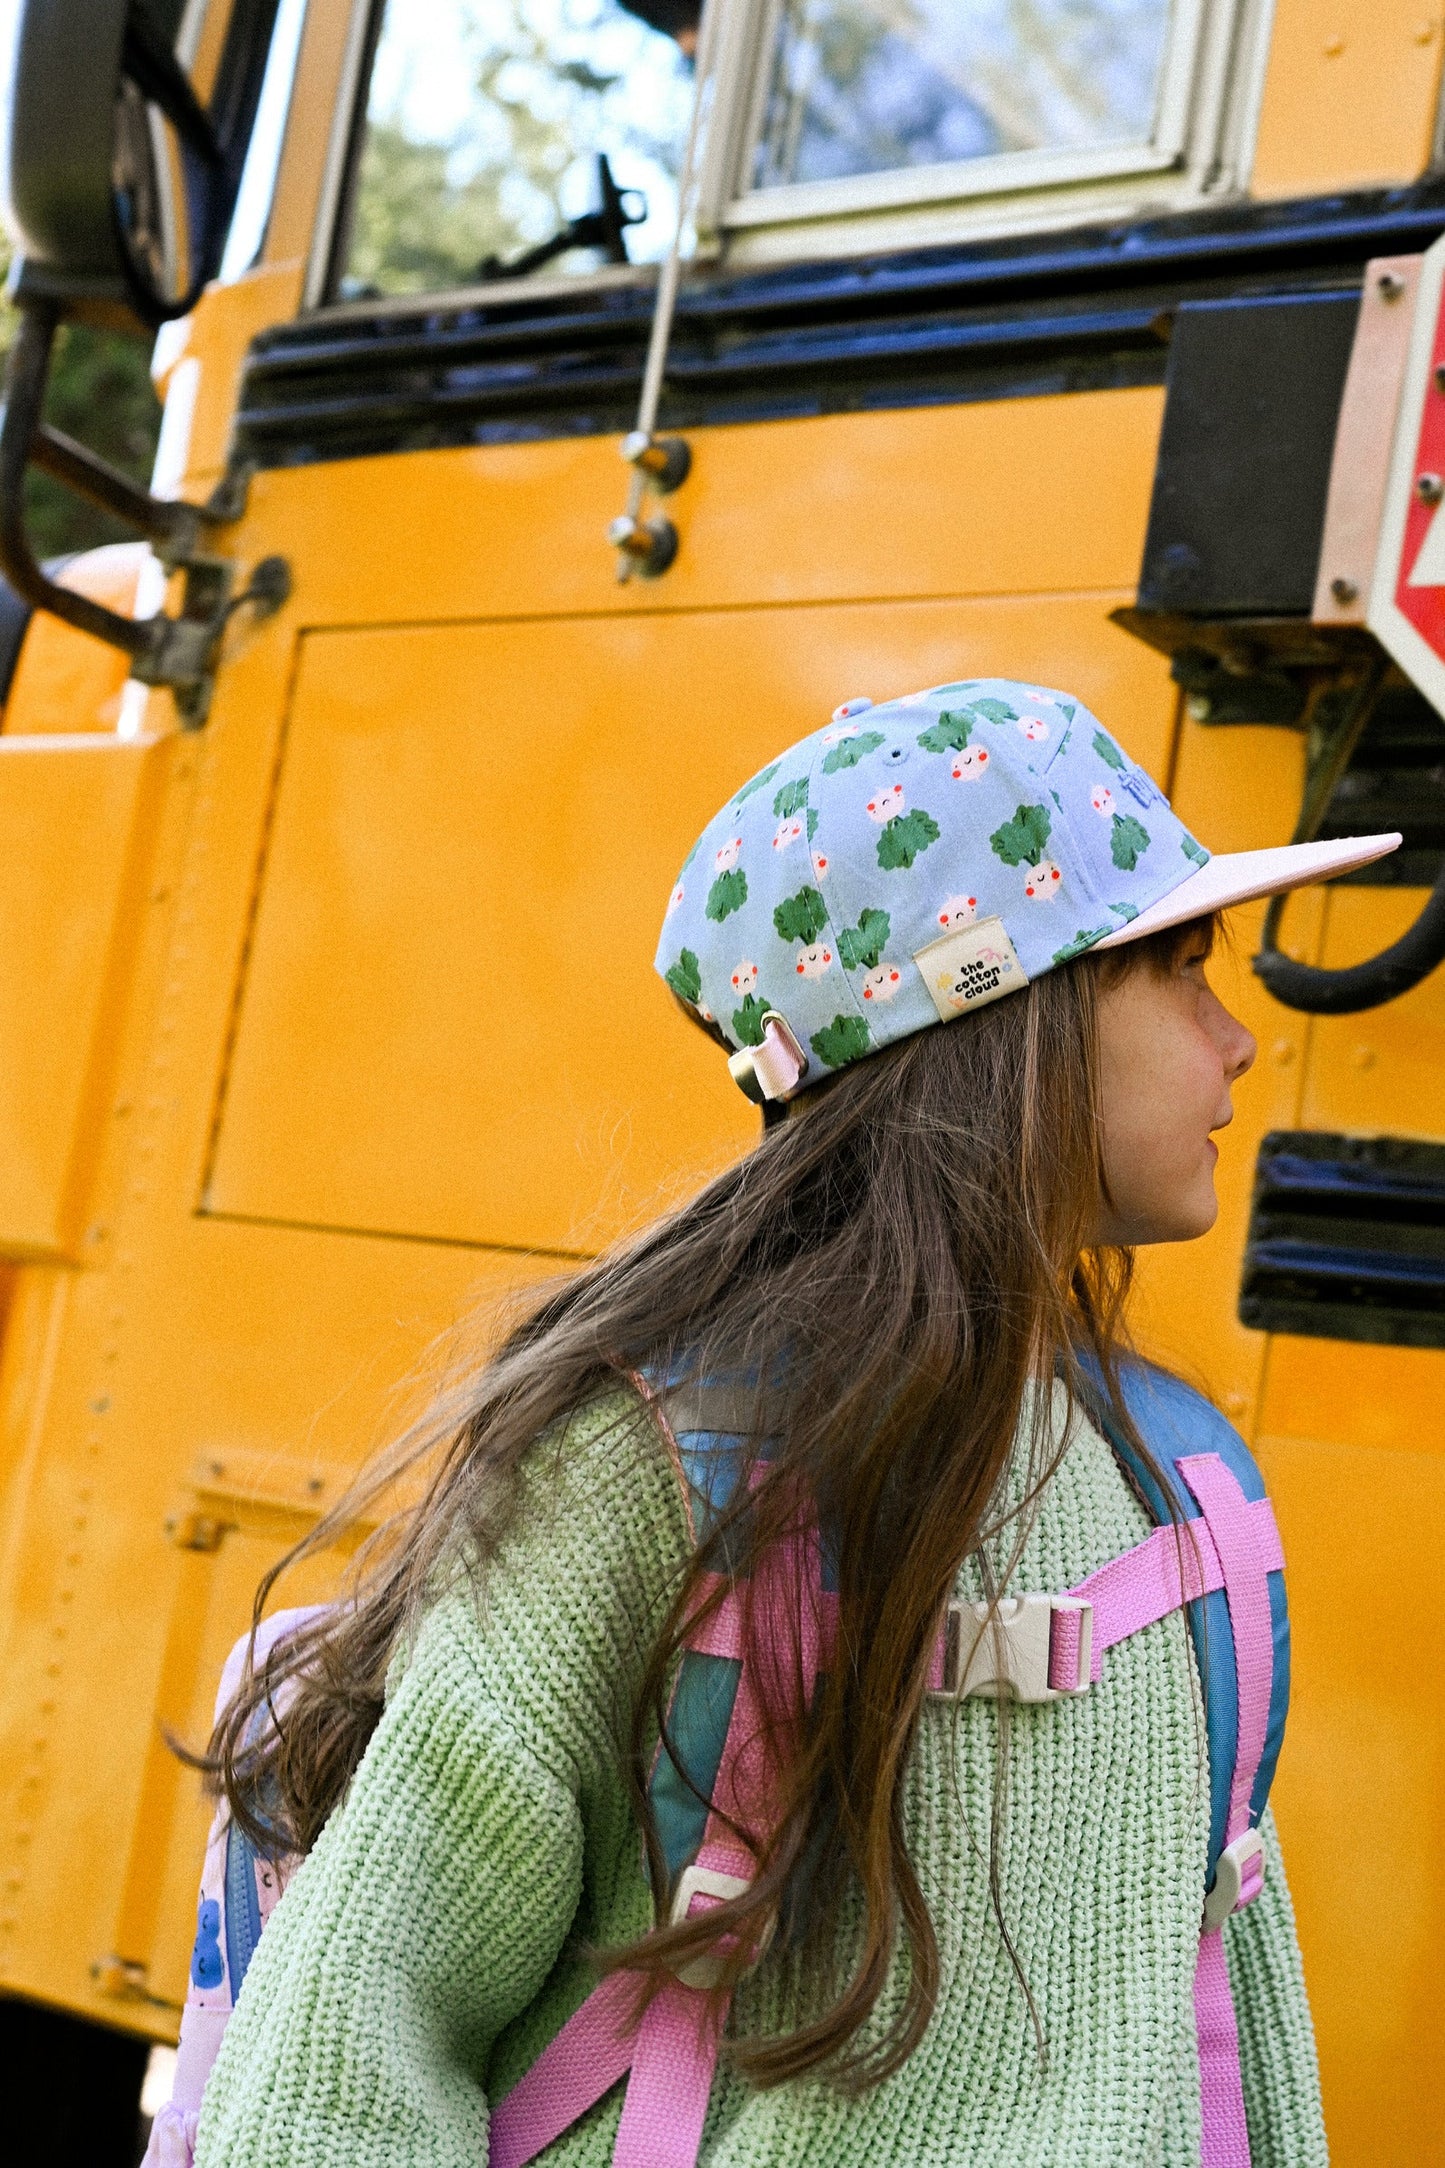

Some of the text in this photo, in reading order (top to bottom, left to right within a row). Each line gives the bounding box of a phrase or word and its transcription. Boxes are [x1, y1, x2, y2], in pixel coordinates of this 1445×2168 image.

[954, 966, 1001, 993] cotton
[960, 960, 985, 976] the
[964, 976, 1000, 999] cloud
